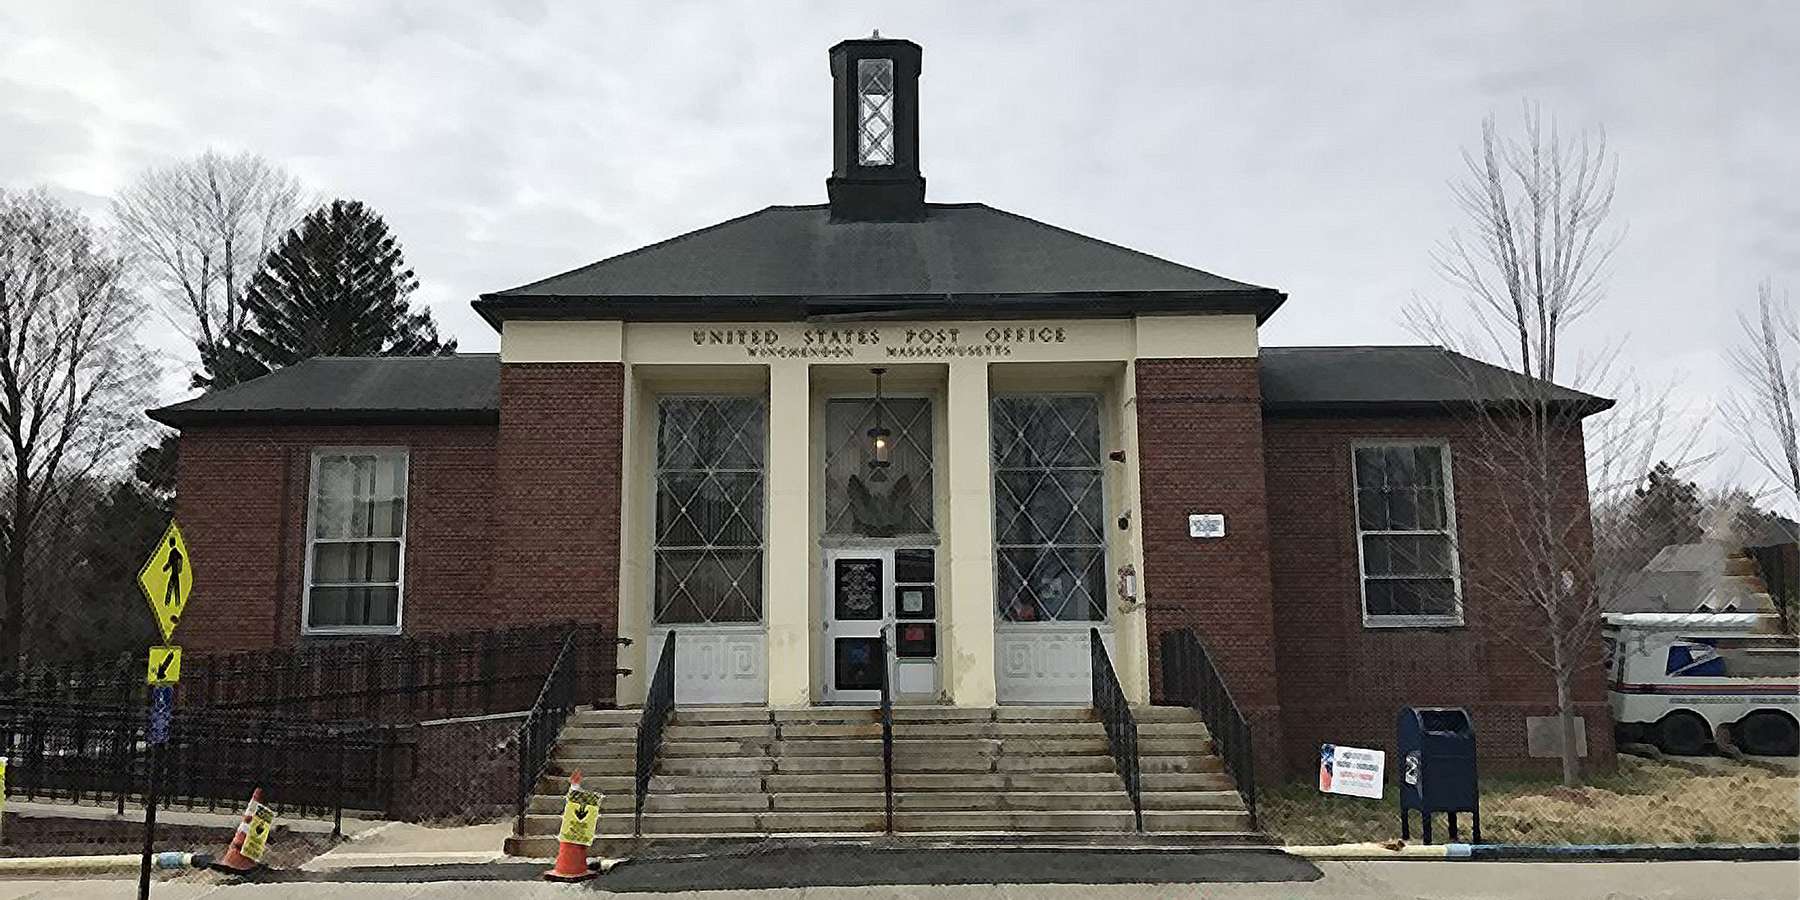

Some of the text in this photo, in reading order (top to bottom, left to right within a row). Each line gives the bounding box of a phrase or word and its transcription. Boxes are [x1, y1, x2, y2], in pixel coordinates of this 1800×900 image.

[693, 327, 1066, 345] UNITED STATES POST OFFICE
